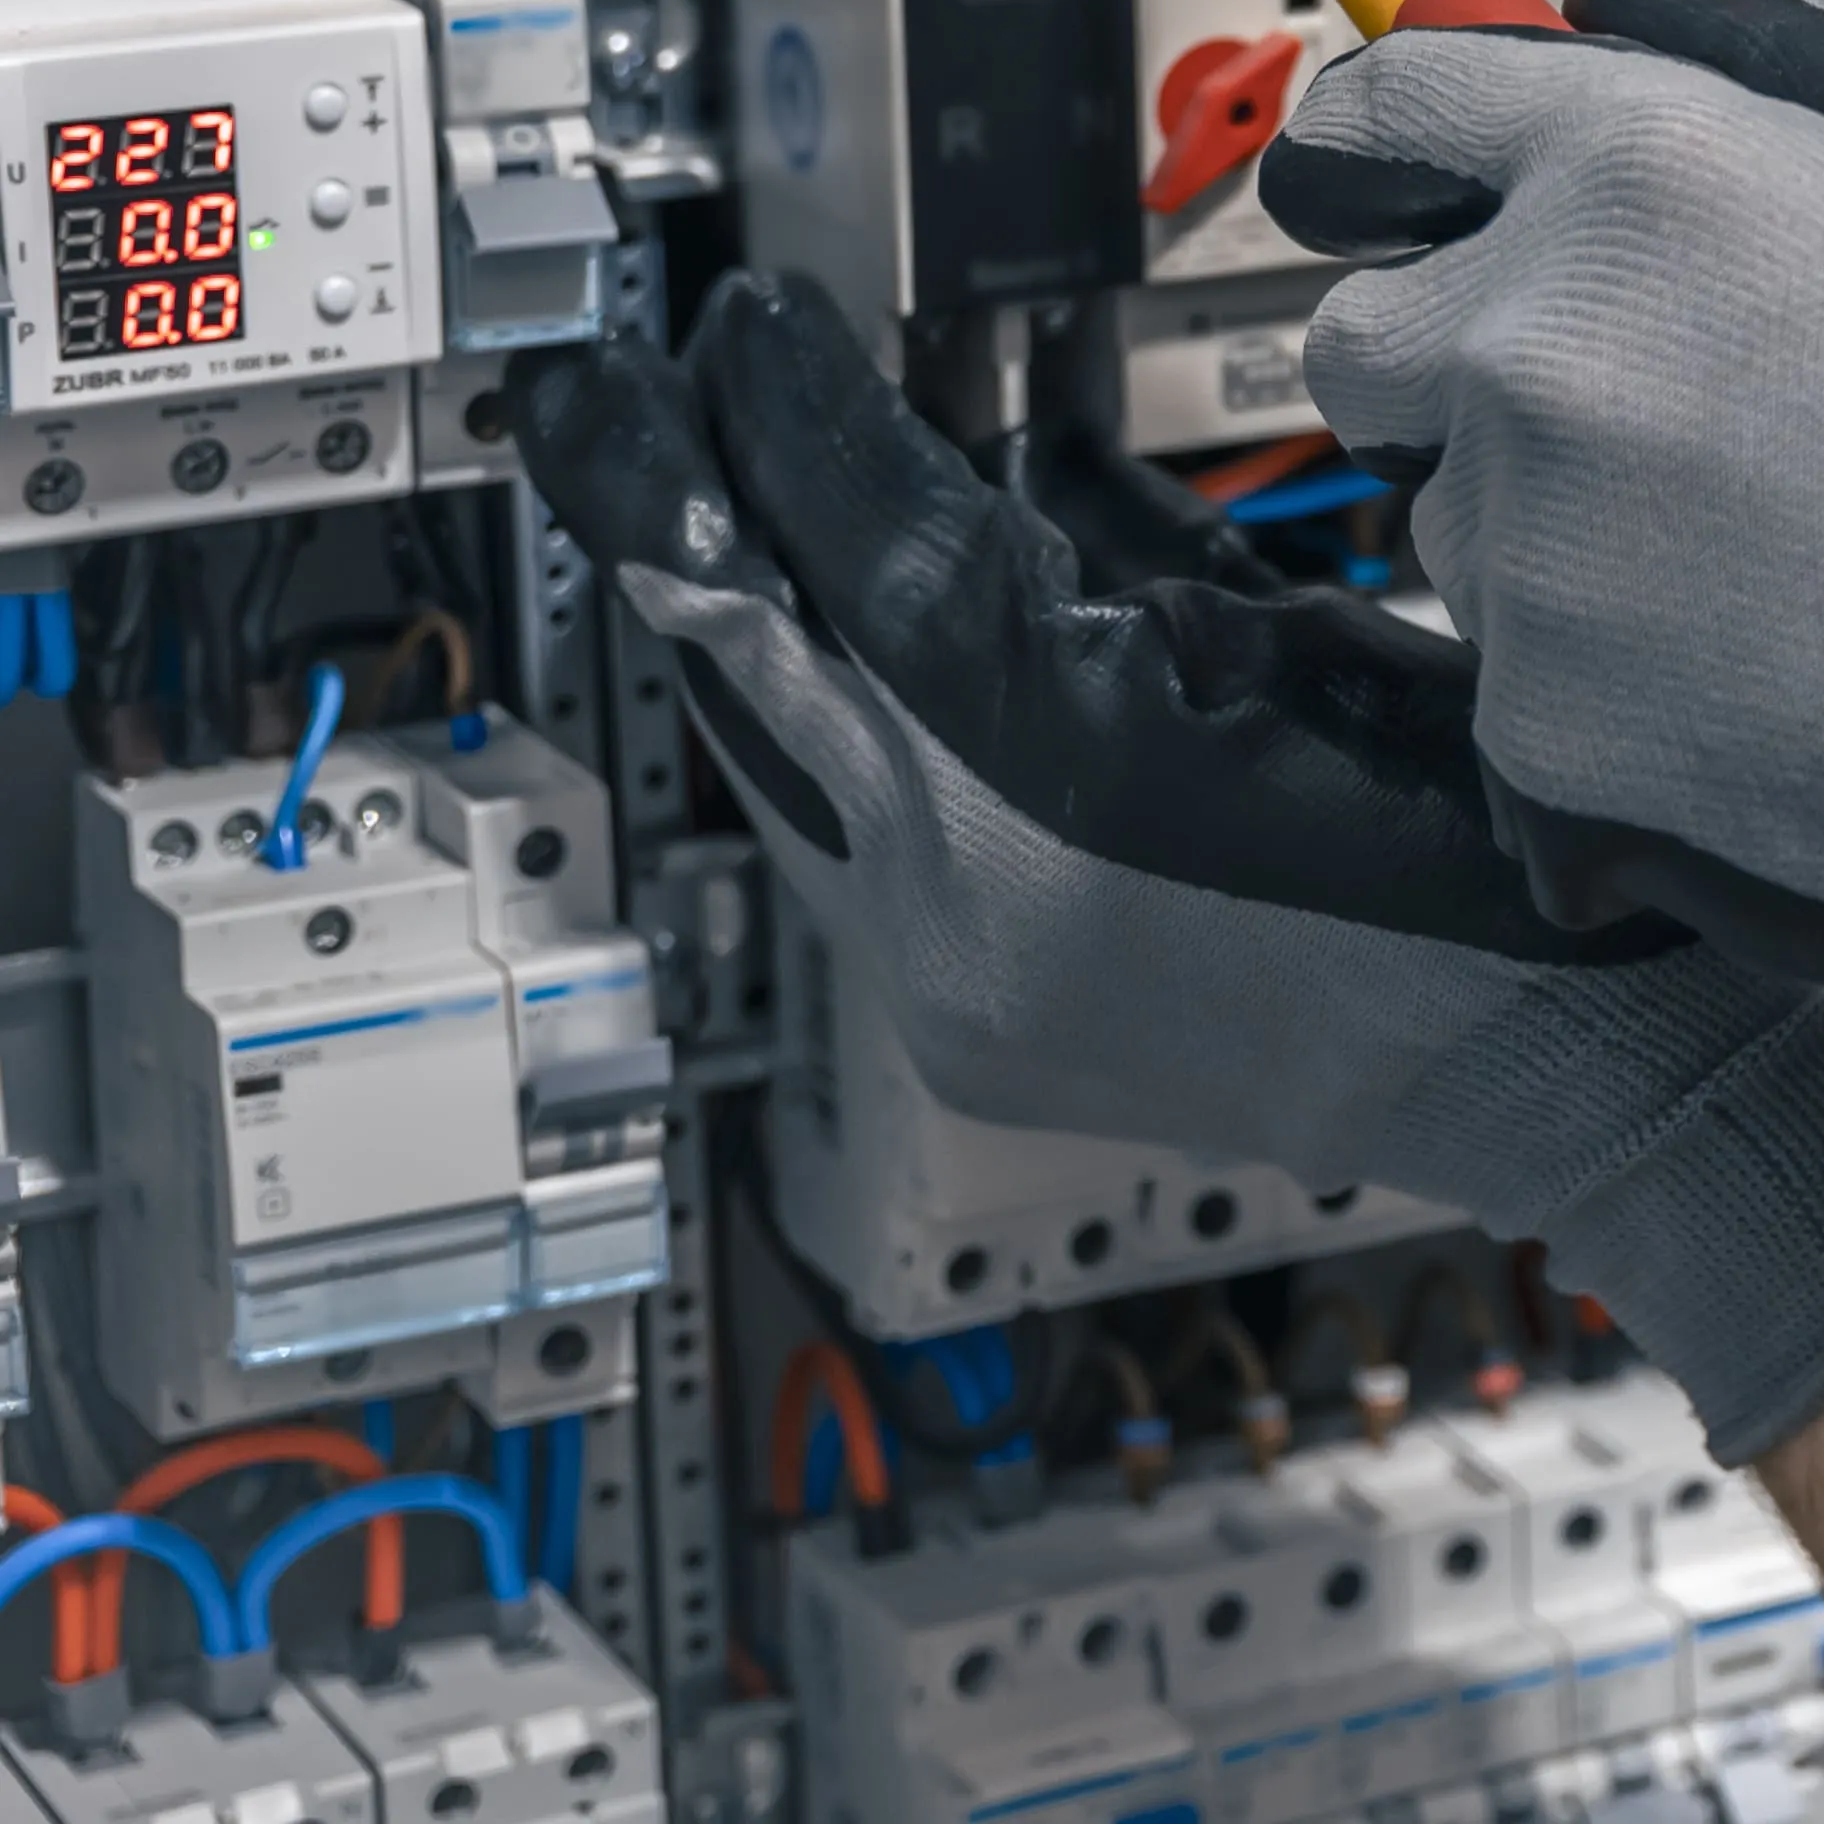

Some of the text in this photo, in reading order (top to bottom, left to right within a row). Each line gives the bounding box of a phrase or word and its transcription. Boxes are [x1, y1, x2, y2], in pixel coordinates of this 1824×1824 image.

[7, 161, 26, 185] U
[51, 111, 234, 192] 227
[118, 192, 237, 267] 0.0
[18, 322, 35, 344] P
[122, 274, 240, 349] 0.0
[52, 368, 124, 395] ZUBR
